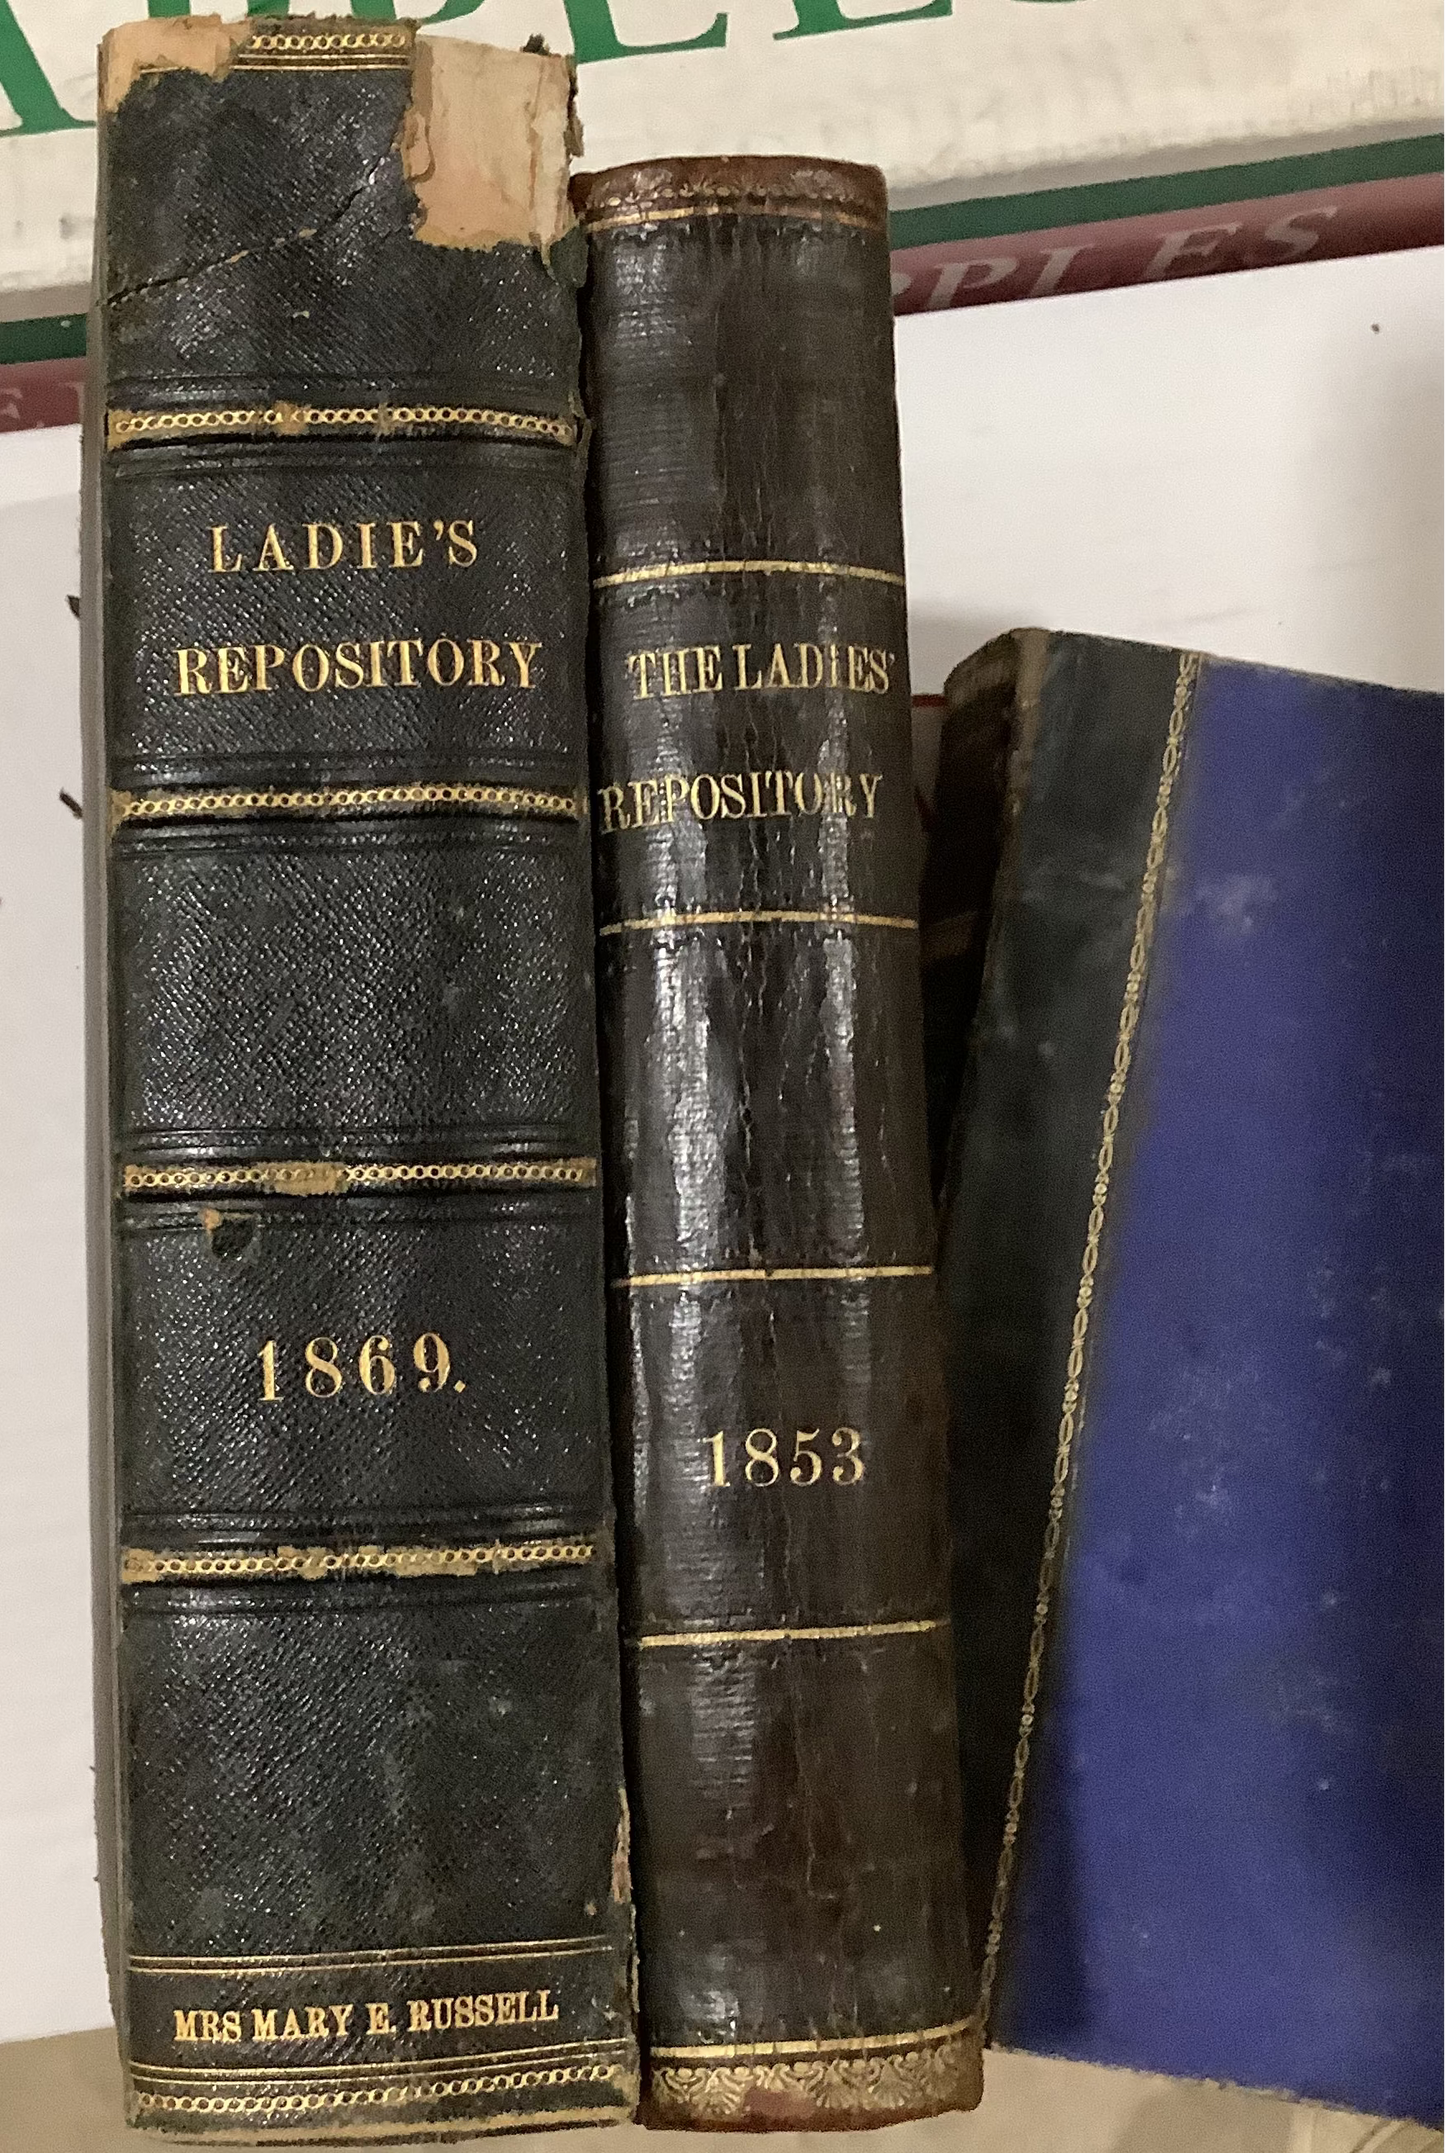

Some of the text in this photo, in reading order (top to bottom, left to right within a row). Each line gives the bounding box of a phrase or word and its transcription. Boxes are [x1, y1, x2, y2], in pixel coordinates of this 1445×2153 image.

[207, 519, 478, 573] LADIE'S
[172, 639, 543, 696] REPOSITORY
[627, 643, 895, 699] THE LADIES'
[597, 770, 883, 834] REPOSITORY
[257, 1332, 467, 1401] 1869.
[703, 1426, 865, 1488] 1853
[173, 1989, 560, 2042] MRS MARY E. RUSSELL
